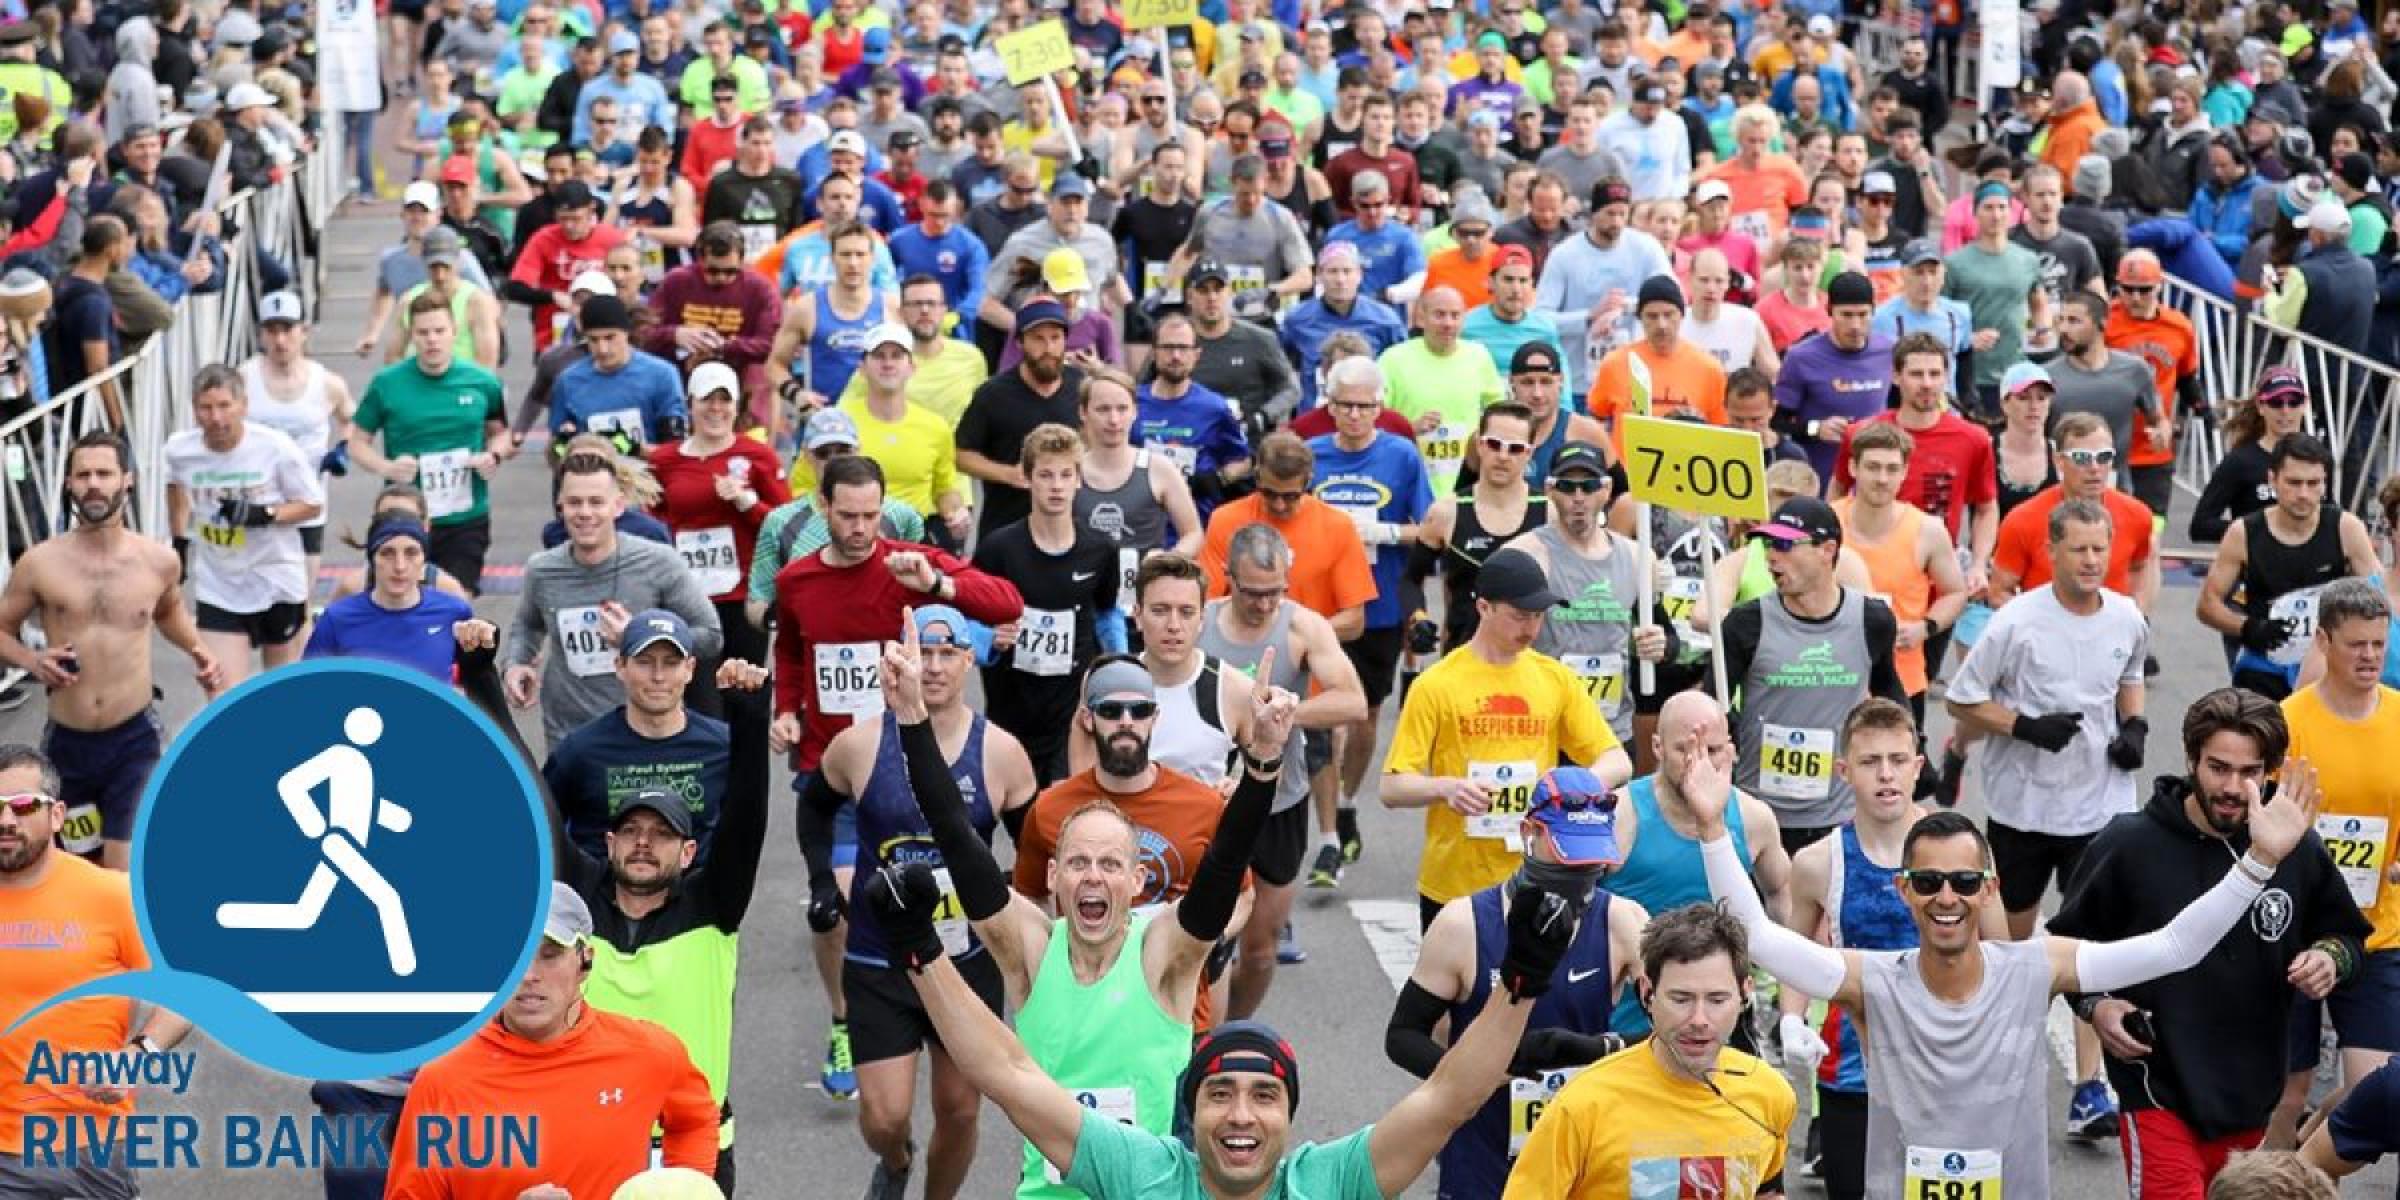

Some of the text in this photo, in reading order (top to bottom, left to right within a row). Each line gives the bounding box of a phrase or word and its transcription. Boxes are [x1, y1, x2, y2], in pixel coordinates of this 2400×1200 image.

[1007, 35, 1064, 71] 7:30
[1425, 440, 1460, 460] 439
[1636, 447, 1753, 500] 7:00
[1016, 631, 1071, 656] 4781
[819, 666, 880, 691] 5062
[1771, 752, 1820, 777] 496
[1487, 786, 1528, 812] 49
[2325, 839, 2375, 868] 522
[1919, 1180, 1985, 1200] 581
